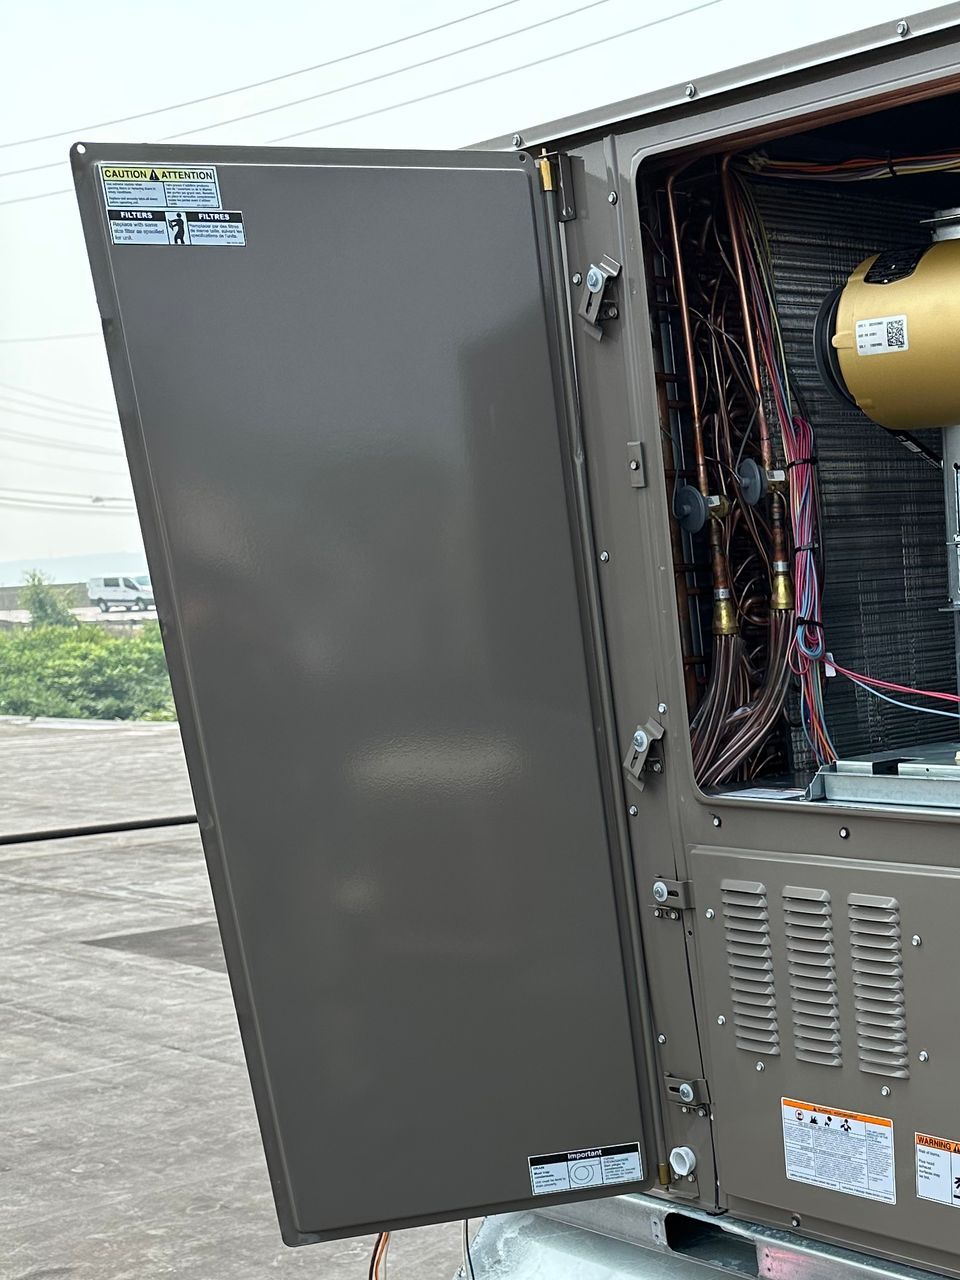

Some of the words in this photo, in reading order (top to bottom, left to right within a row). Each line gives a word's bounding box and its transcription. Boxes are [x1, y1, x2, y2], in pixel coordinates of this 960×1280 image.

[104, 169, 147, 179] CAUTION
[161, 170, 213, 180] ATTENTION
[120, 211, 153, 219] FILTERS
[198, 213, 230, 221] FILTRES
[918, 1136, 951, 1150] WARNING
[567, 1149, 603, 1160] Important
